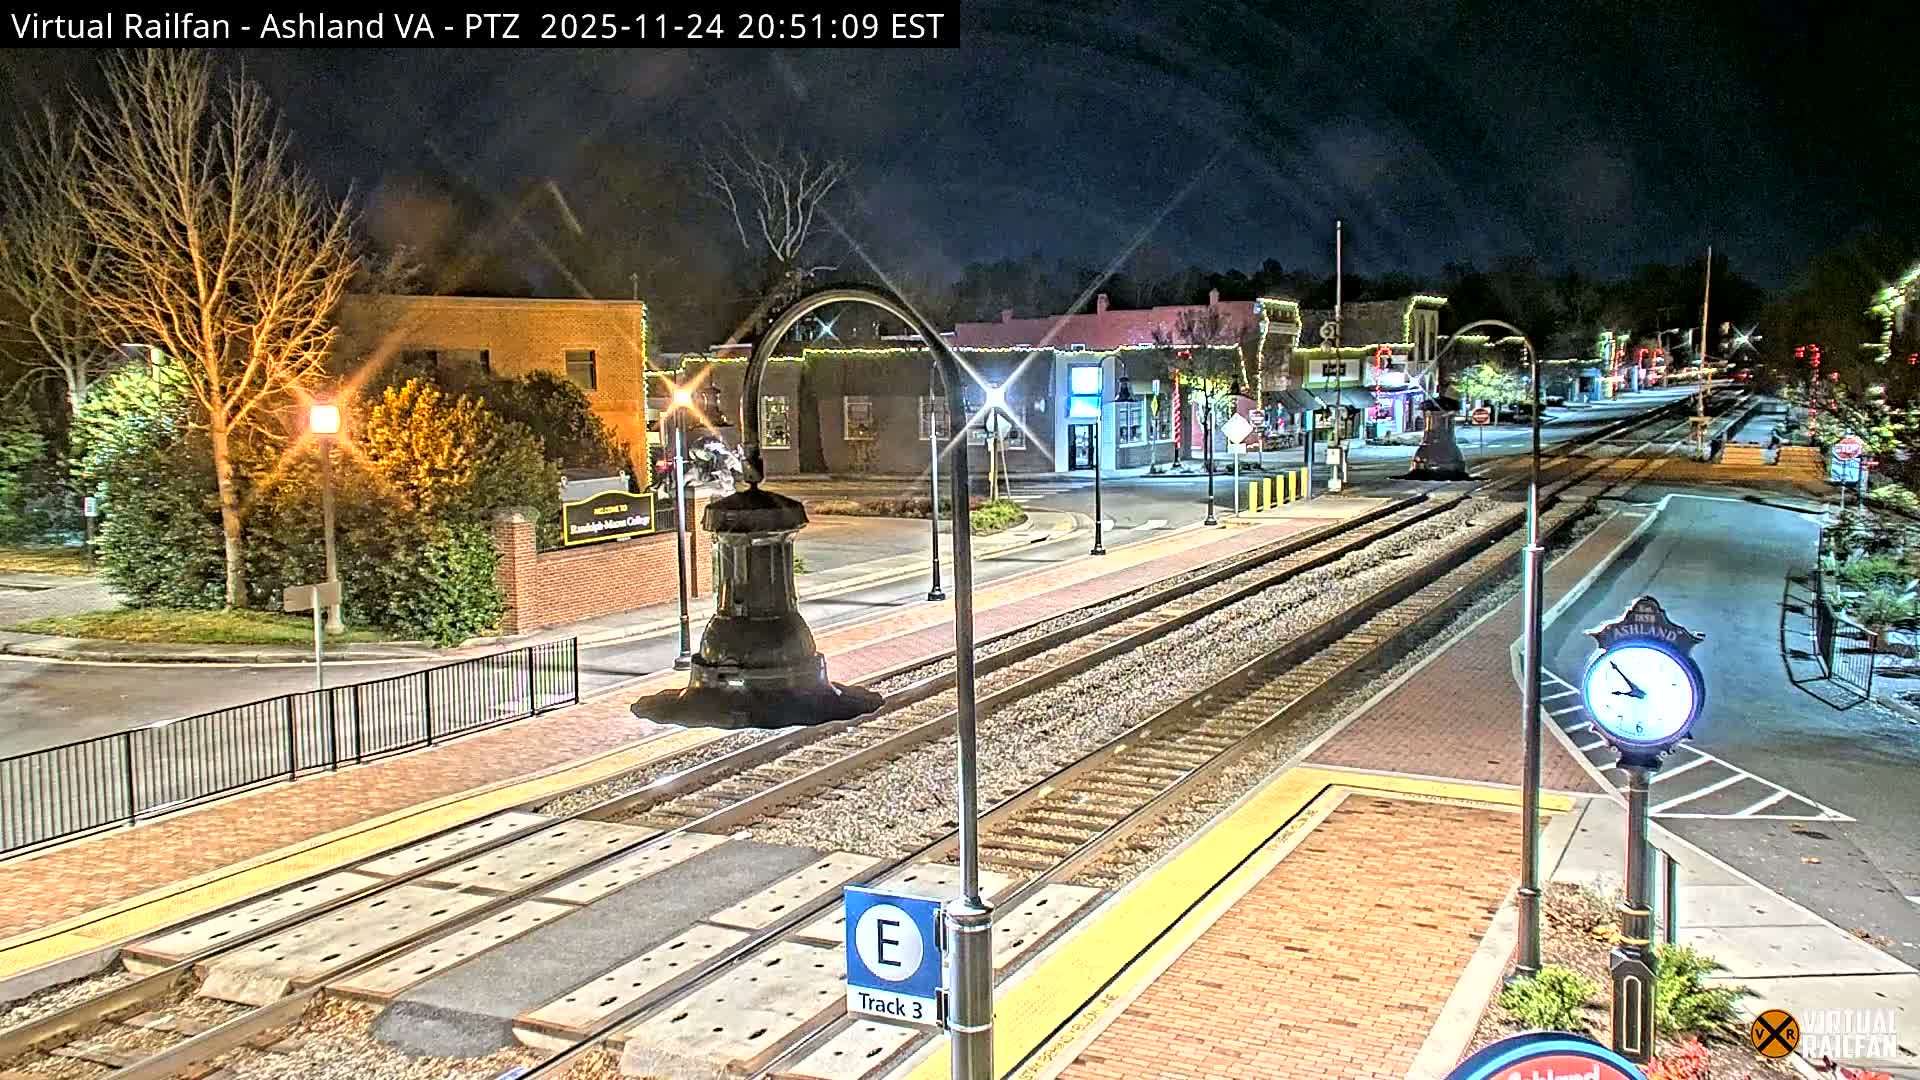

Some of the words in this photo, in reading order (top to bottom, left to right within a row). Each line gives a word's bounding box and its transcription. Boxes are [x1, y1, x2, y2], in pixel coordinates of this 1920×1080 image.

[1835, 443, 1859, 454] STOP
[1614, 624, 1678, 641] ASHLAND
[877, 918, 901, 967] E
[858, 991, 906, 1017] Track
[912, 1001, 923, 1019] 3
